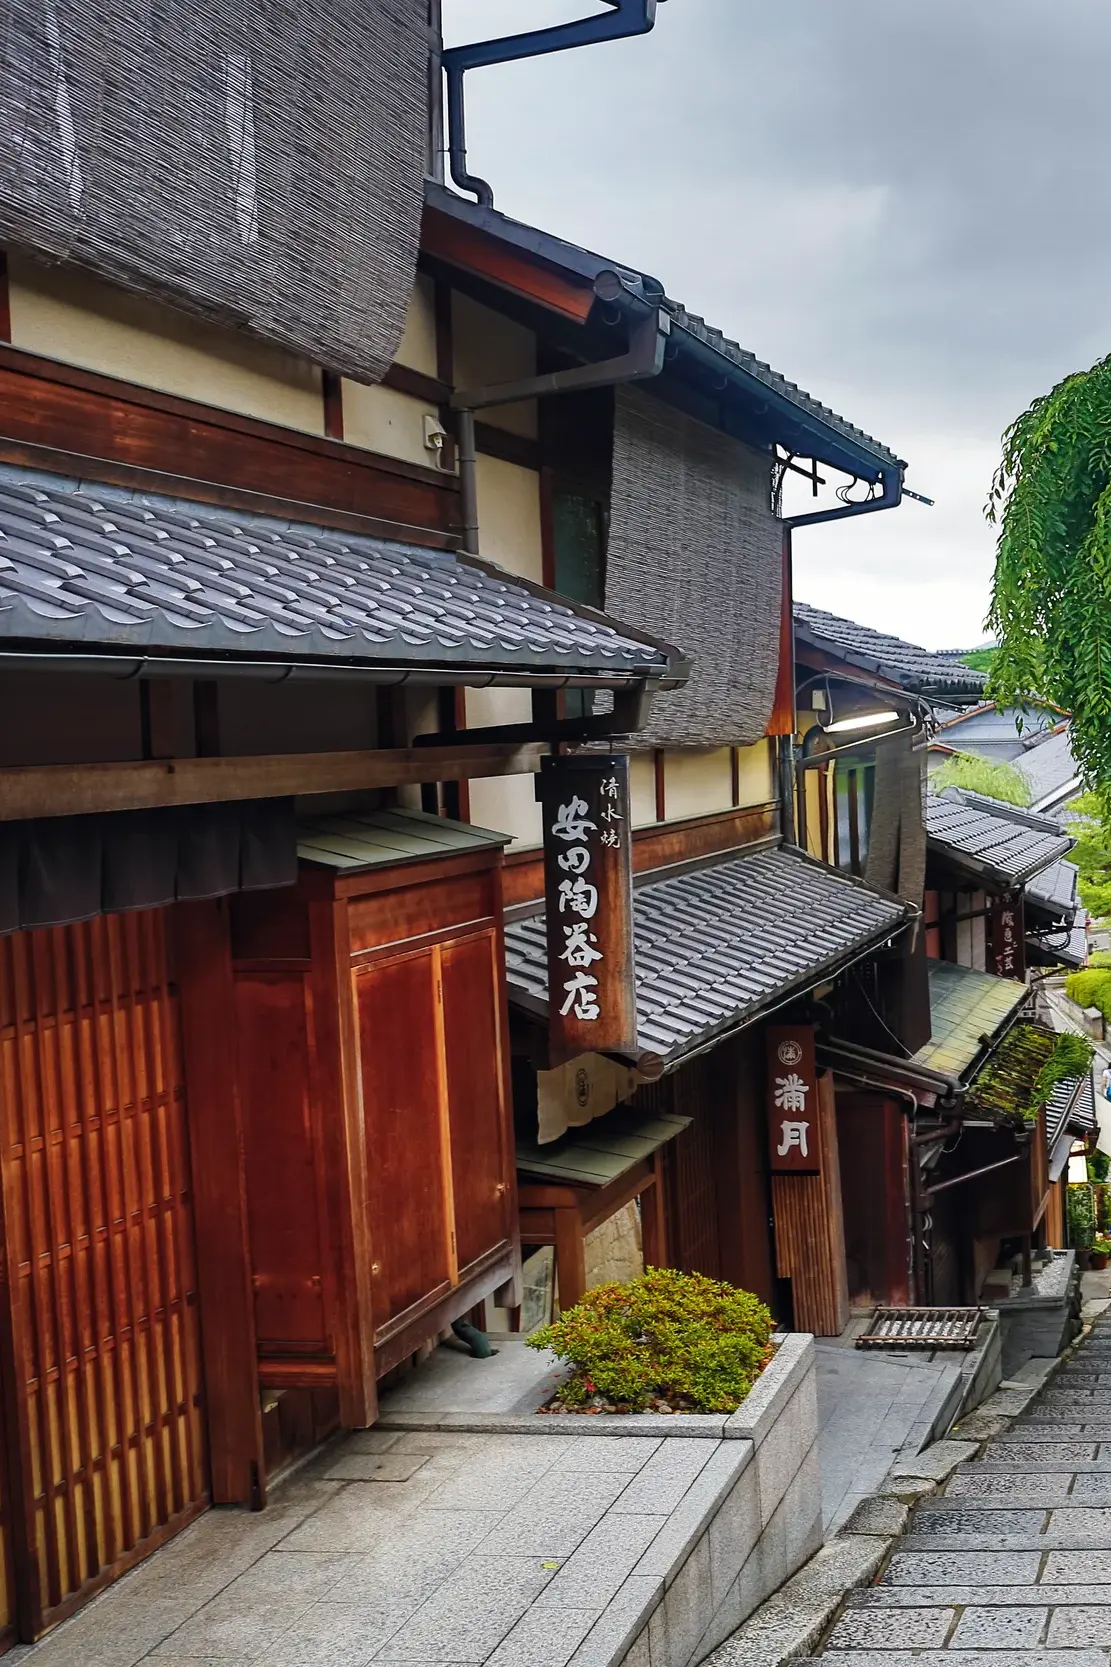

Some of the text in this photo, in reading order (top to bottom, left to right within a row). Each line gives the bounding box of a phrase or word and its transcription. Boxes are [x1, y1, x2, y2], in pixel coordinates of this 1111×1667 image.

[552, 796, 603, 1020] 安田陶器店
